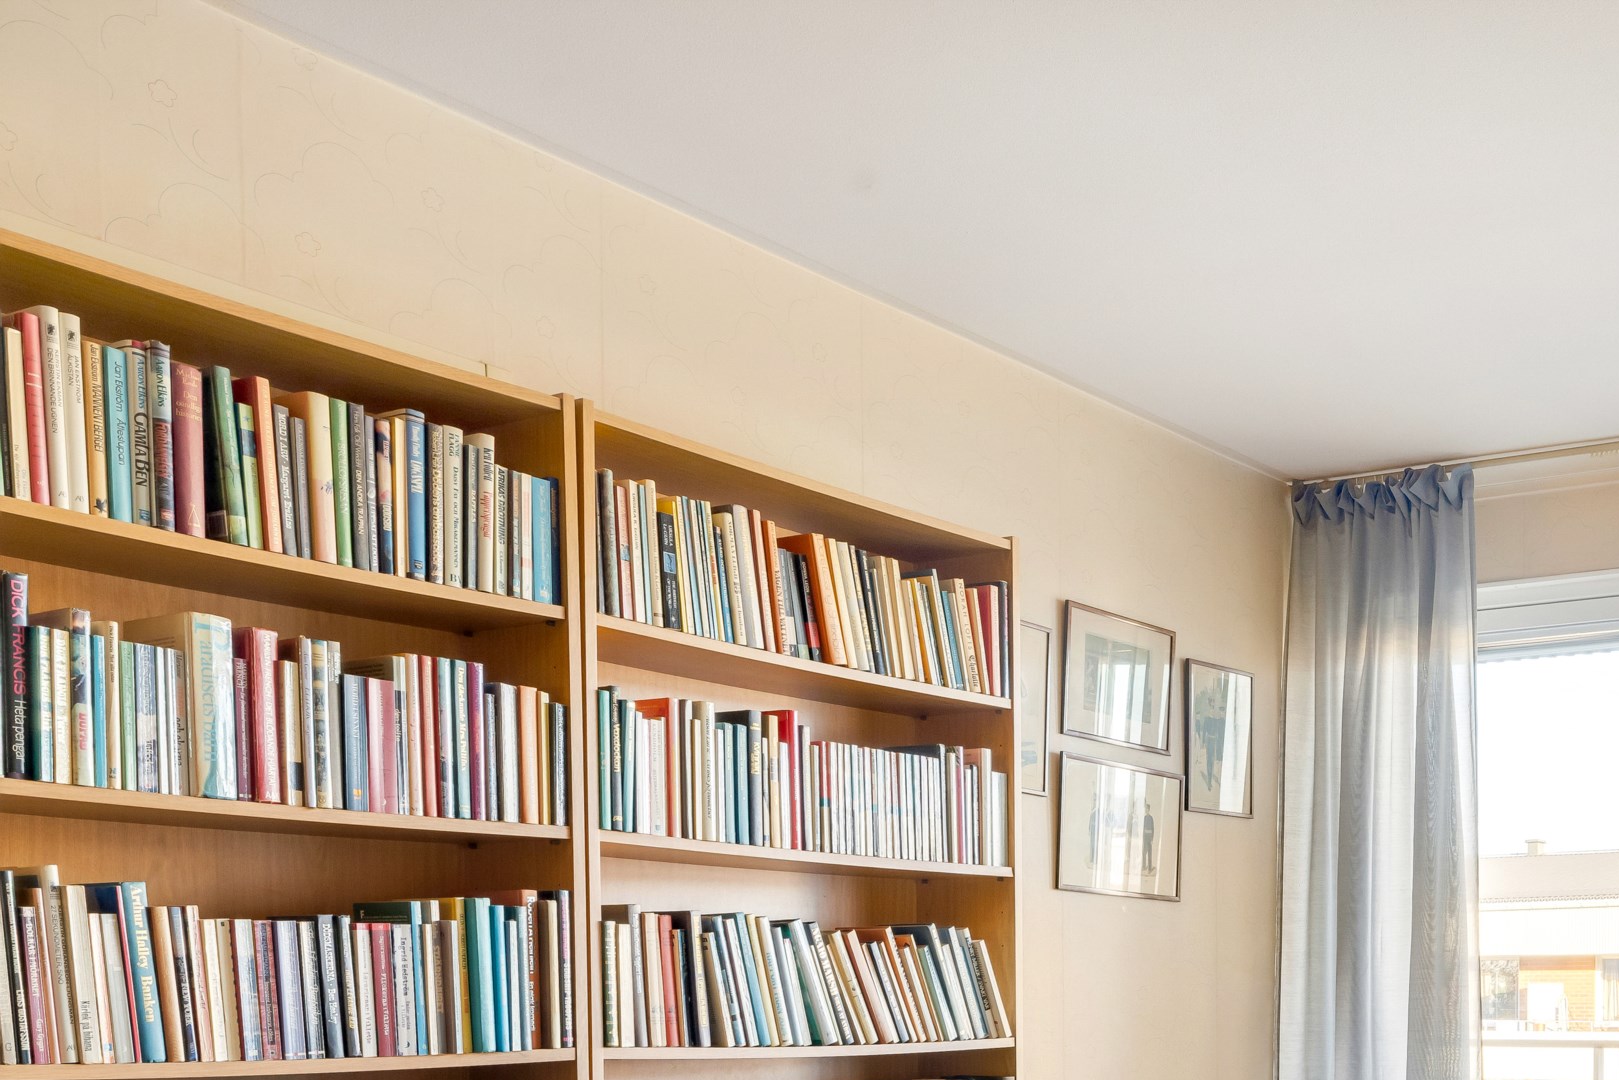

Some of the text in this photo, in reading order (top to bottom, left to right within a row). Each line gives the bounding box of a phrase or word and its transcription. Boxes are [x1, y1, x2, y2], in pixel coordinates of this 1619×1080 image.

[114, 361, 123, 378] Jan
[115, 379, 124, 412] Ekström
[50, 408, 58, 433] UGNEN
[277, 413, 287, 436] MORD
[280, 444, 288, 460] ARV
[135, 459, 150, 487] BEN
[280, 465, 290, 499] Margaret
[11, 579, 27, 761] DICK FRANCIS Heta pengar
[613, 723, 621, 772] Vaxdockan
[129, 885, 155, 1023] Arthur Hailey Banken
[398, 937, 410, 996] Ingrid Hedström
